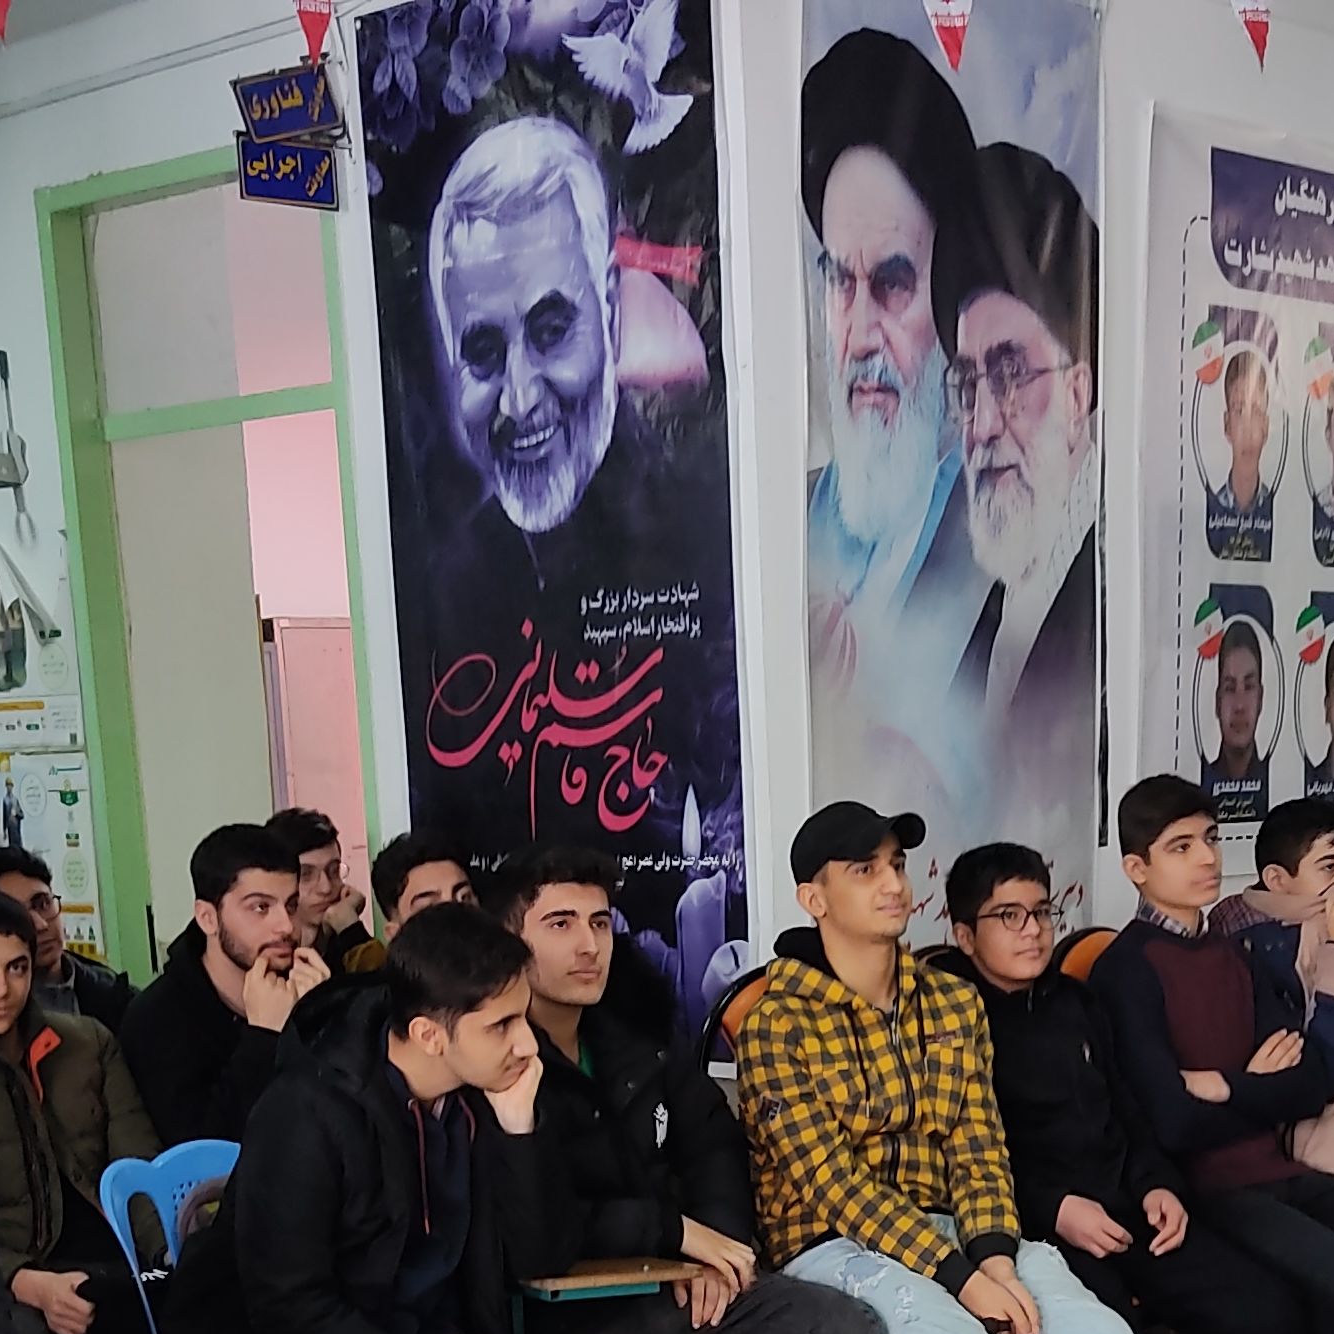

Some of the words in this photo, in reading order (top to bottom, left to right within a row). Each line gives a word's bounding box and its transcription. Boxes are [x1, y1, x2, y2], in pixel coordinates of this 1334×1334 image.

[249, 77, 304, 120] فناوری
[247, 148, 302, 182] اجرایی
[1223, 237, 1274, 282] بشارت
[1275, 246, 1315, 284] شهید
[580, 595, 588, 616] و
[589, 587, 620, 614] بزرگ
[621, 585, 655, 613] سردار
[657, 580, 700, 608] شهادت
[583, 621, 617, 647] سپهبد
[598, 730, 669, 833] حاج
[1212, 779, 1241, 797] محمدی
[1241, 779, 1262, 793] محمد
[654, 849, 671, 873] ولی
